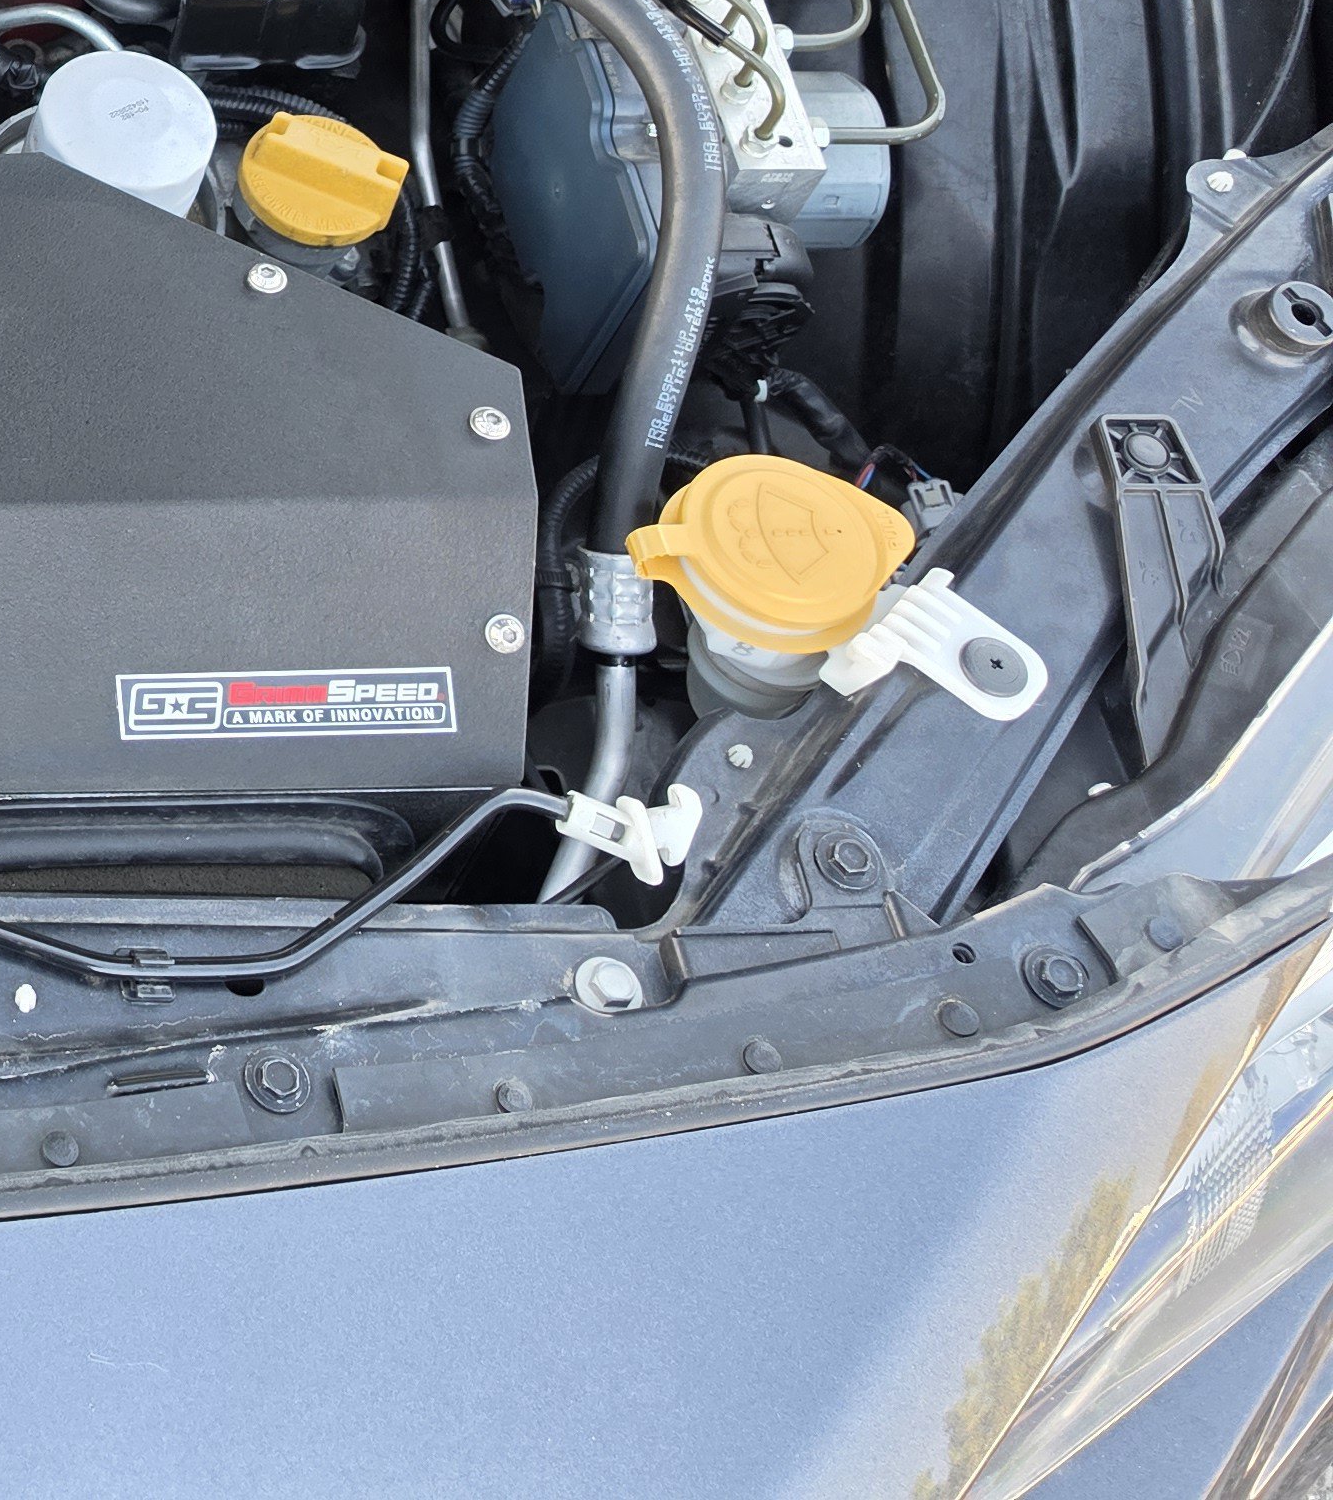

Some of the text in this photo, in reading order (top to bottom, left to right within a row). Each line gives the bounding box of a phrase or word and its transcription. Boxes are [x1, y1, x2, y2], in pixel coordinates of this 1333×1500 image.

[232, 706, 436, 725] A MARK OF INNOVATION
